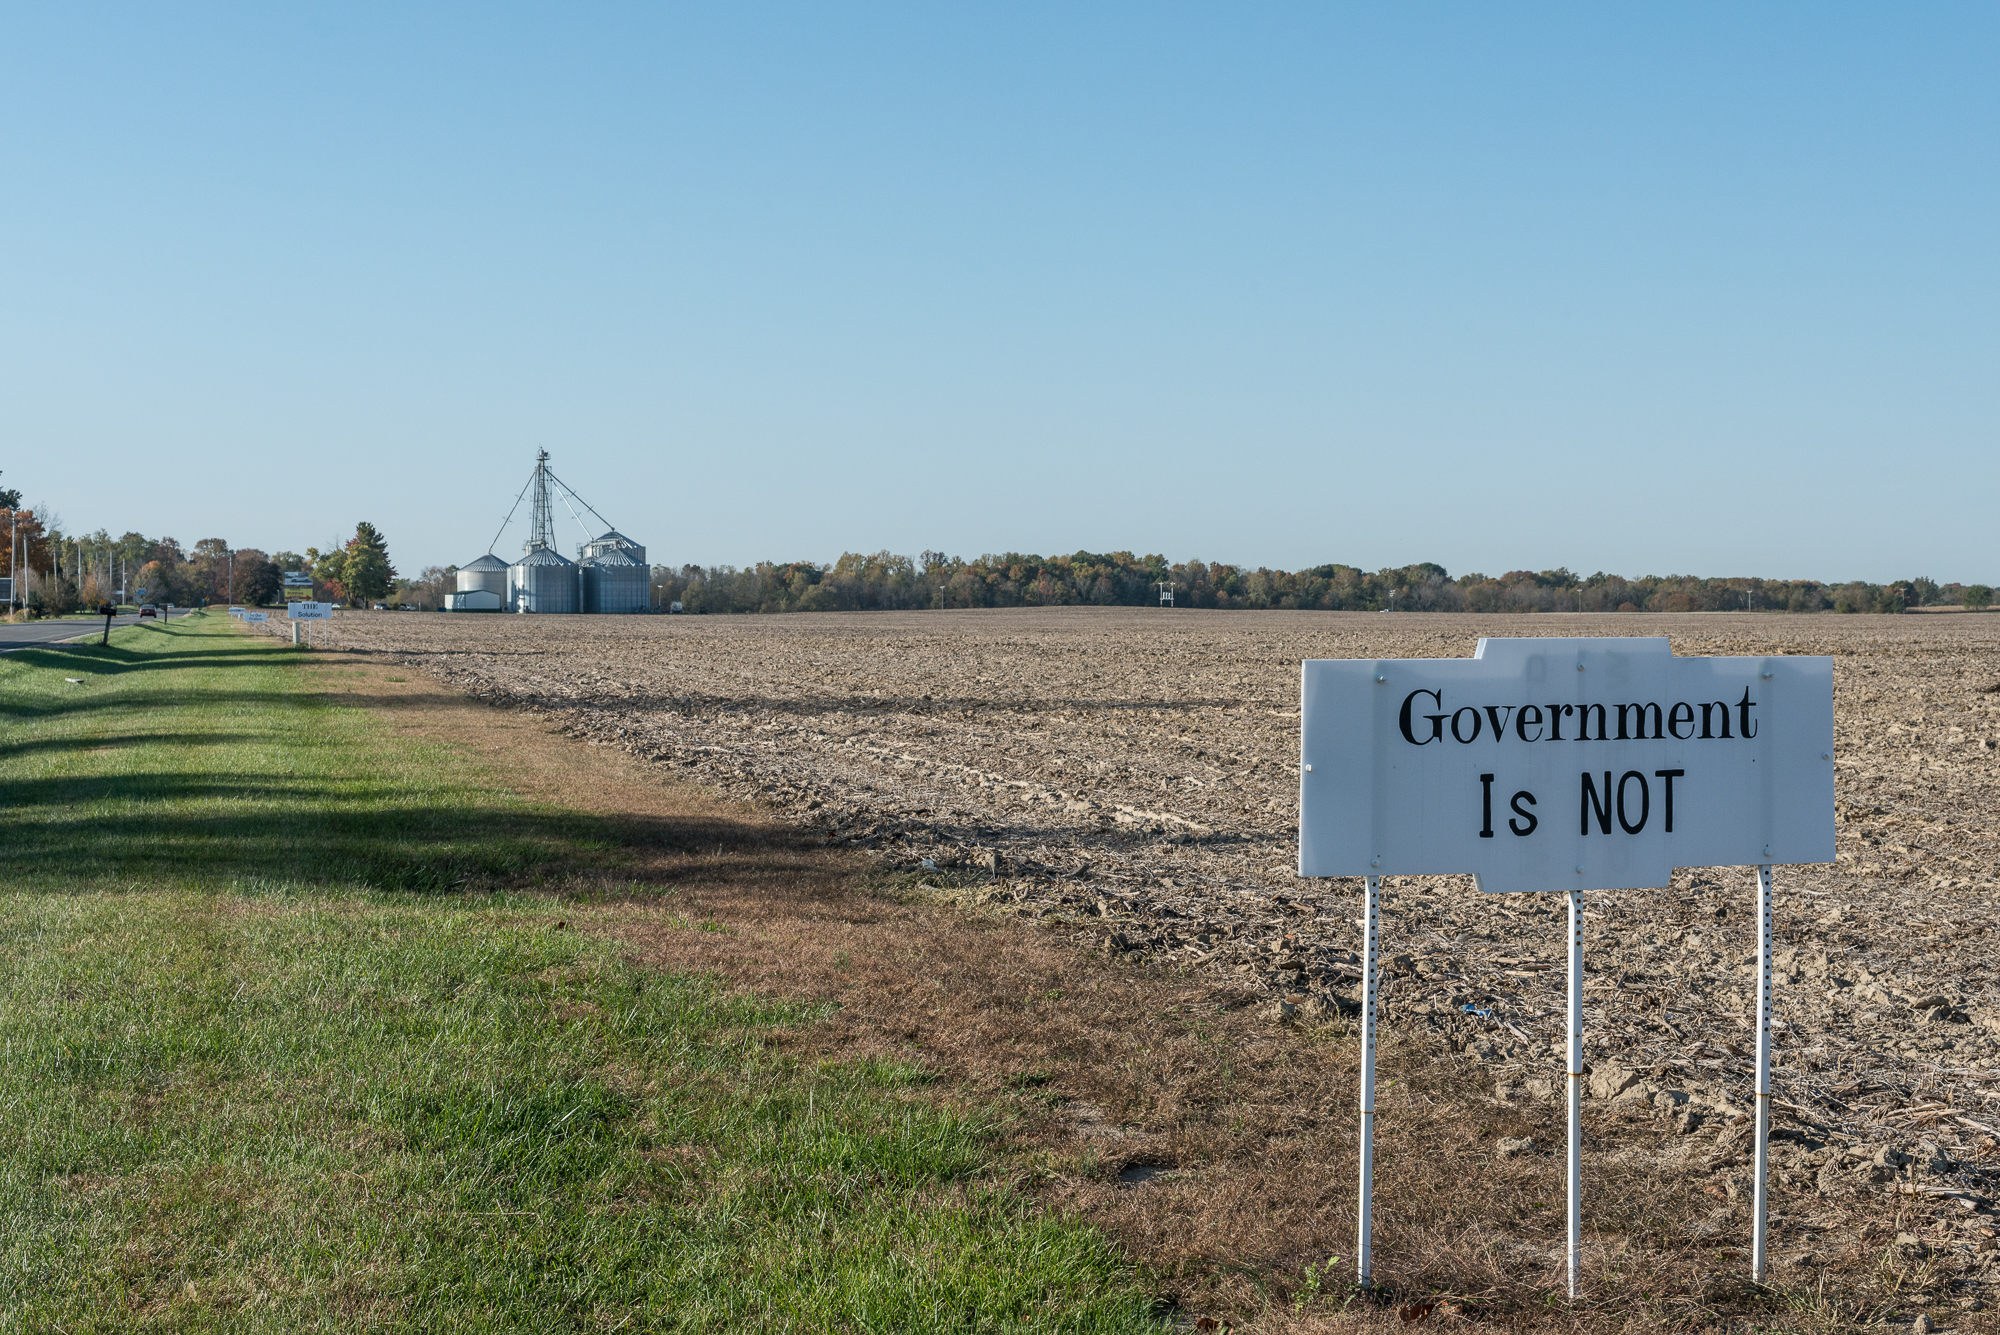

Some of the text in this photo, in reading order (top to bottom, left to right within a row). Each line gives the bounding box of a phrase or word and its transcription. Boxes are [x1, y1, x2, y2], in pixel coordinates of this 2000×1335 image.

[1399, 686, 1757, 745] Government
[1479, 769, 1684, 838] Is NOT
